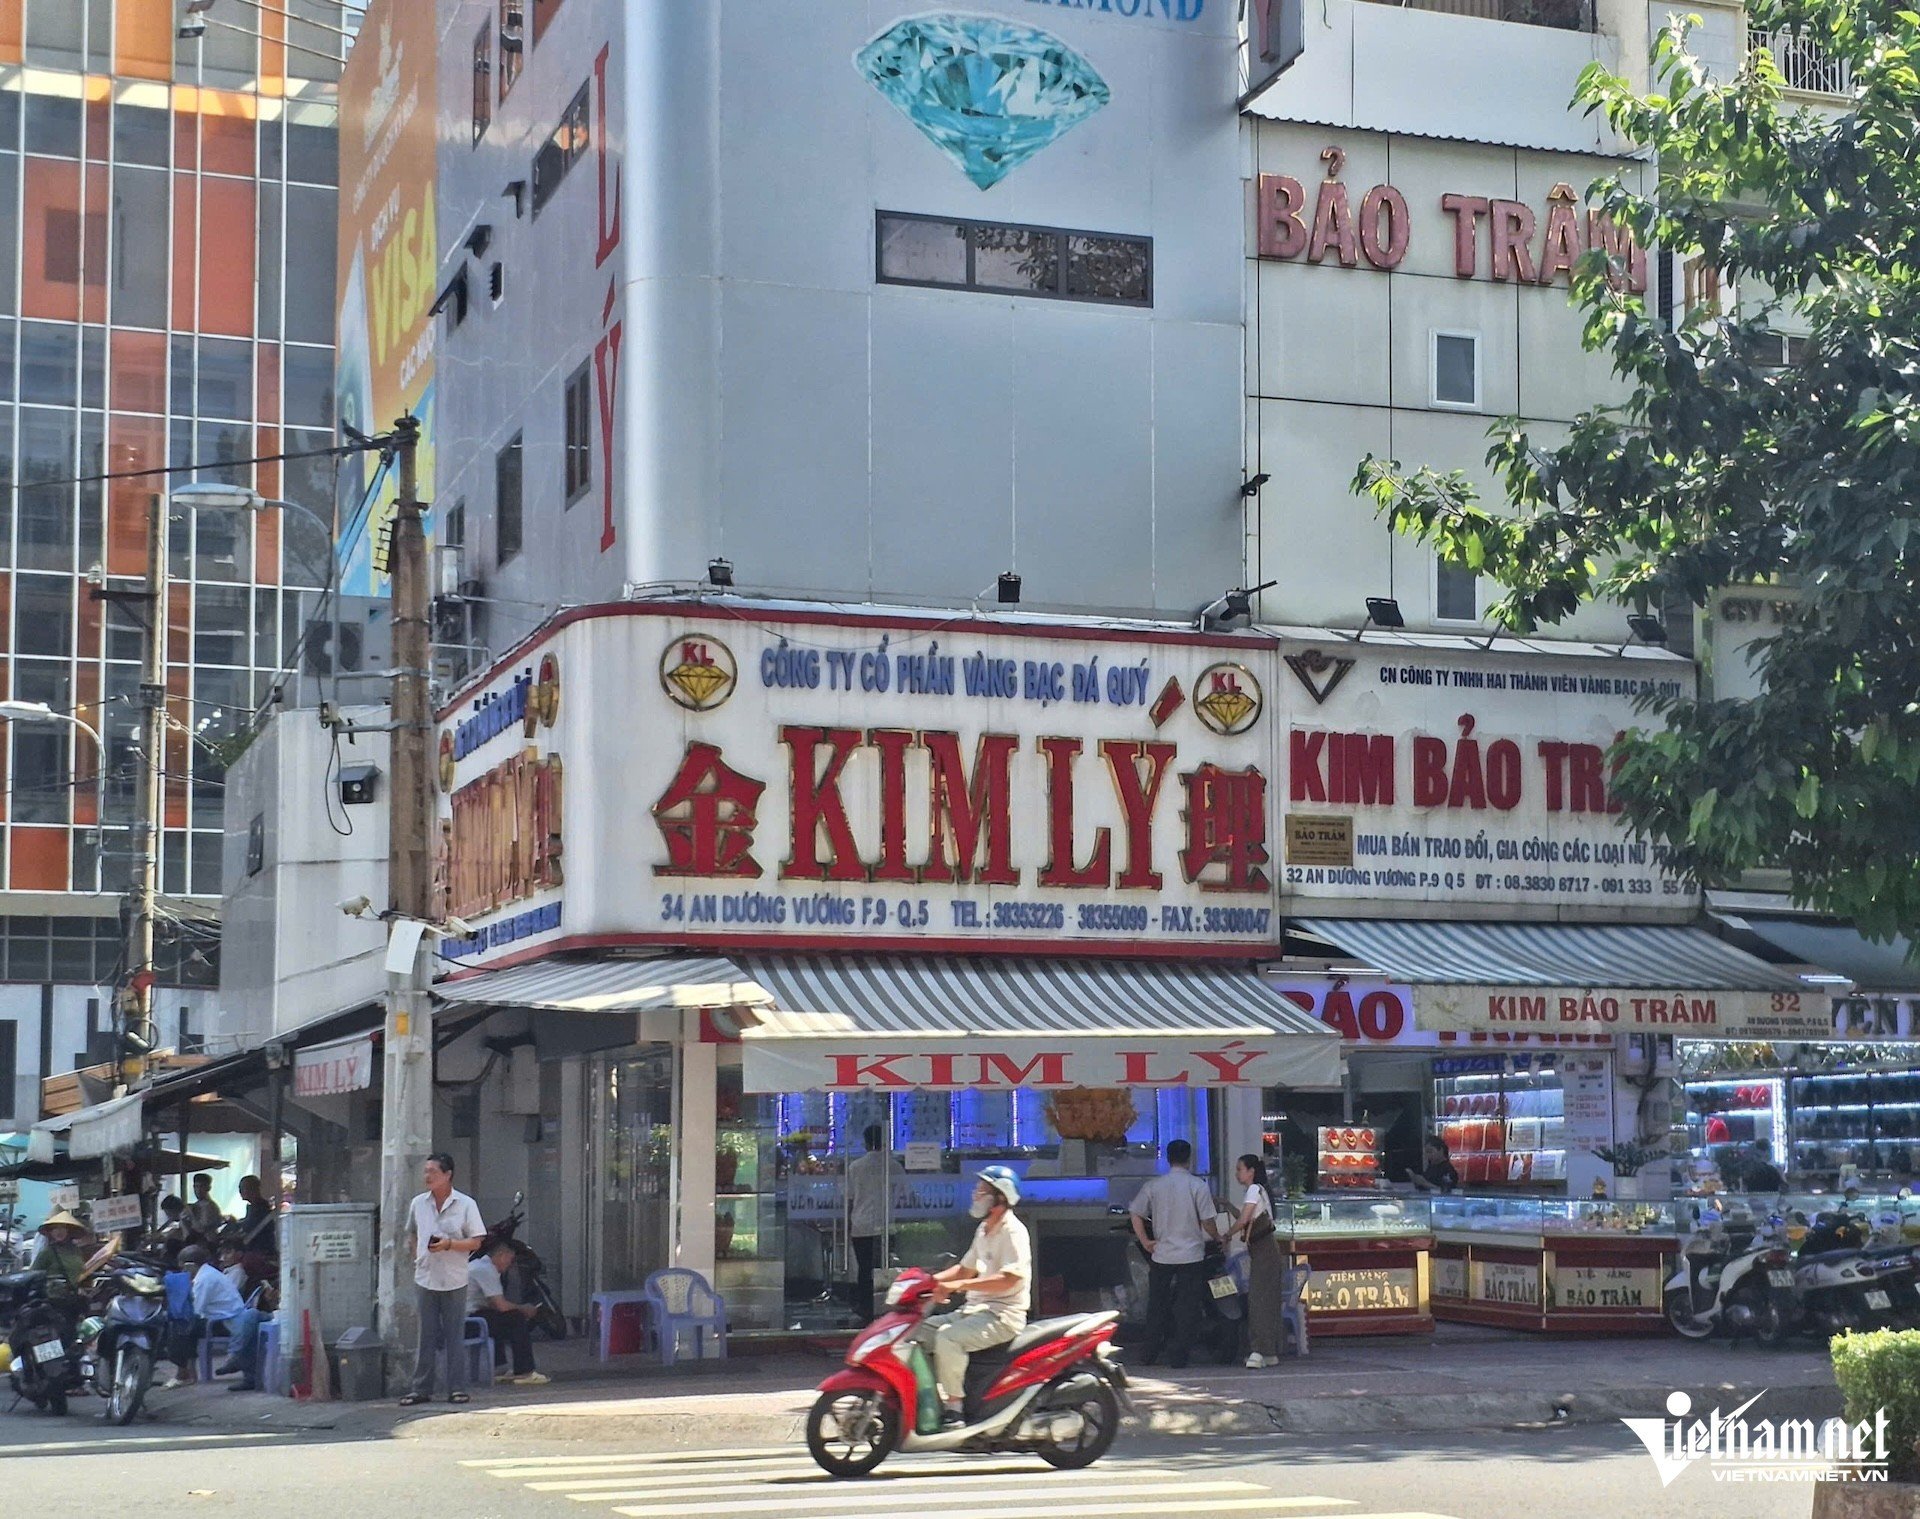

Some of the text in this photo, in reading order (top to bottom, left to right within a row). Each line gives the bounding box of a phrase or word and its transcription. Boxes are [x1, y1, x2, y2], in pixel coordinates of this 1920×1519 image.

[1258, 146, 1648, 295] BẢO TRÂM
[371, 179, 437, 367] VISA
[681, 642, 716, 666] KL
[760, 636, 821, 690] CÔNG
[825, 650, 856, 692] TY
[860, 633, 891, 693] CỔ
[962, 650, 1017, 699] VÀNG
[1023, 660, 1065, 708] BẠC
[1072, 655, 1100, 703] ĐÁ
[1106, 657, 1150, 706] QUÝ
[1210, 671, 1243, 694] KL
[1379, 666, 1397, 684] CN
[1400, 664, 1433, 686] CÔNG
[1435, 669, 1450, 687] TY
[1452, 671, 1484, 689] TNHH
[1486, 672, 1507, 690] HAI
[1509, 671, 1549, 692] THÀNH
[1550, 673, 1578, 694] VIÊN
[1580, 675, 1612, 696] VÀNG
[1613, 678, 1638, 699] BẠC
[778, 724, 1021, 888] KIM
[1036, 675, 1187, 891] LÝ
[1290, 728, 1395, 806] KIM
[1412, 712, 1522, 811] BẢO
[652, 740, 767, 880] 金
[1357, 834, 1388, 856] MUA
[1391, 831, 1420, 857] BÁN
[1424, 837, 1462, 859] TRAO
[1465, 829, 1494, 863] ĐỔI,
[1496, 839, 1519, 861] GIA
[1522, 835, 1559, 862] CÔNG
[1562, 837, 1590, 864] CÁC
[1594, 842, 1626, 868] LOẠI
[1286, 867, 1304, 884] 32
[1306, 868, 1324, 885] AN
[1328, 867, 1371, 886] DƯƠNG
[1374, 868, 1417, 887] VƯƠNG
[1419, 872, 1440, 888] P.9
[1444, 872, 1455, 889] Q
[1456, 873, 1466, 888] 5
[1475, 873, 1493, 890] ĐT
[1504, 874, 1556, 892] 08.3830
[1601, 878, 1625, 894] 091
[1628, 879, 1653, 895] 333
[1662, 880, 1679, 895] 55
[660, 893, 685, 921] 34
[689, 894, 717, 923] AN
[721, 890, 787, 924] DƯƠNG
[792, 892, 856, 926] VƯƠNG
[861, 896, 887, 926] F.9
[994, 901, 1065, 929] 38353226
[1077, 902, 1148, 931] 38355099
[1203, 906, 1272, 934] 38308047
[1488, 988, 1717, 1024] KIM BẢO TRÂM
[1770, 991, 1801, 1013] 32
[297, 1046, 359, 1092] KIM LÝ
[825, 1040, 1269, 1087] KIM LÝ
[1600, 1285, 1642, 1306] TRÂM
